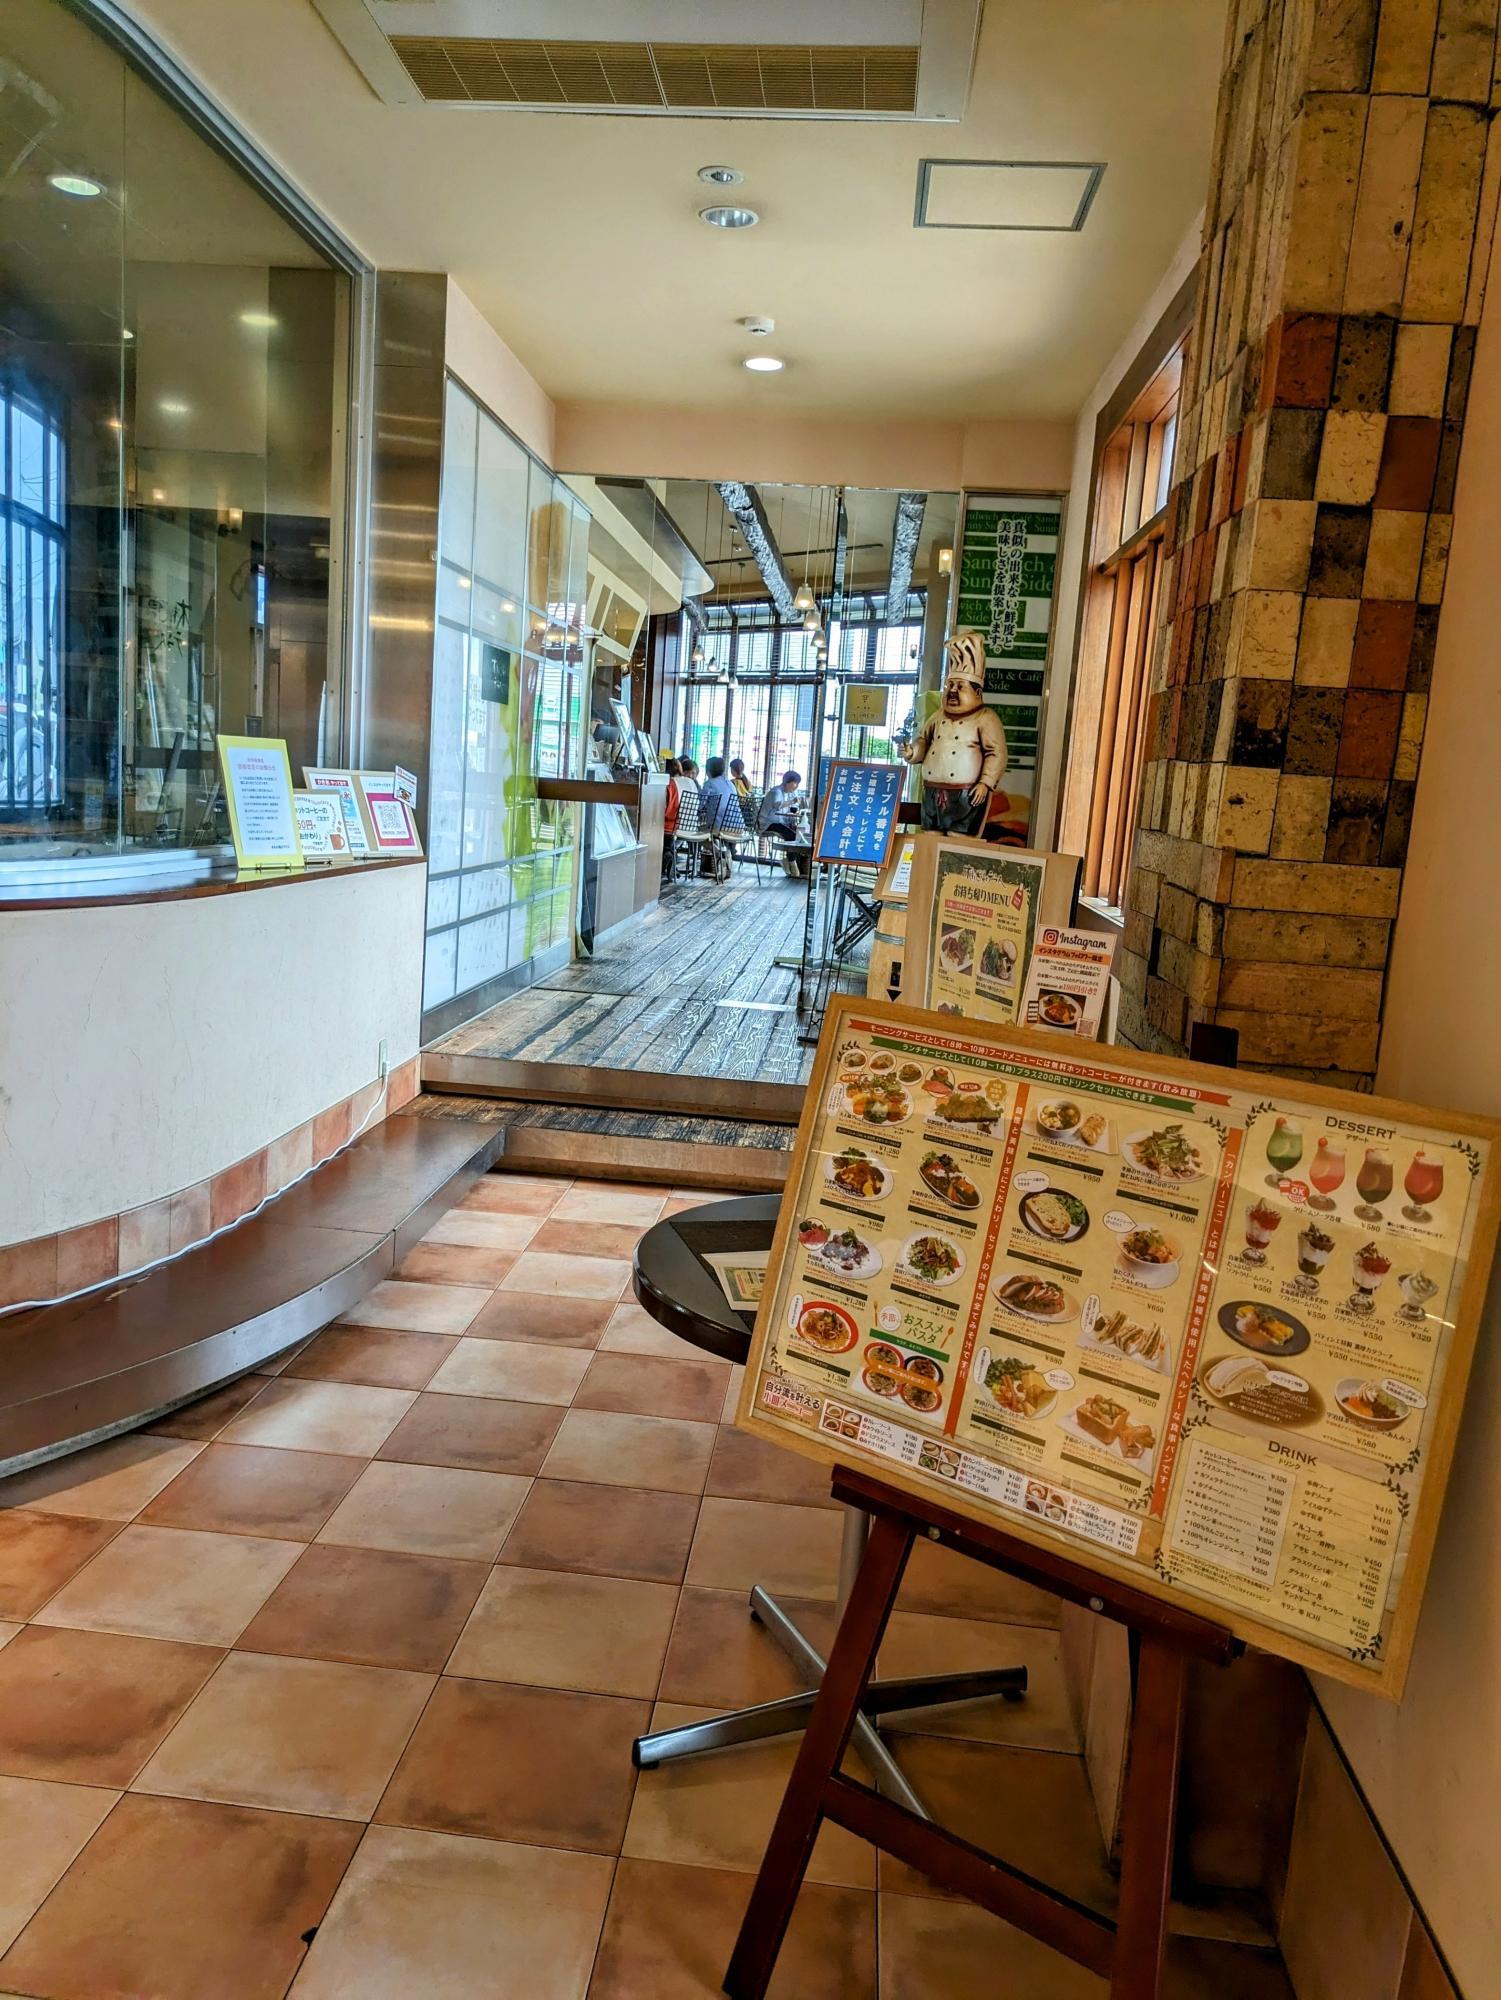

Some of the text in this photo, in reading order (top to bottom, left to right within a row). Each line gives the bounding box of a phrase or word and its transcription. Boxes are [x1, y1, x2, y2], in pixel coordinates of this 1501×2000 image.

[989, 520, 1012, 653] 美味しさを提案します。
[1003, 520, 1025, 648] 真似の出来ない鮮度と
[988, 681, 1010, 691] Side
[830, 768, 849, 828] お願い致します
[839, 770, 865, 858] ご注文・お会計を
[873, 773, 896, 851] テーブル番号を
[1059, 931, 1108, 951] Instagram
[1325, 1115, 1395, 1140] DESSERT
[1290, 1186, 1305, 1196] OK
[1168, 1211, 1196, 1224] ¥1,000
[1360, 1221, 1381, 1233] ¥580
[1252, 1283, 1271, 1293] ¥550
[1306, 1309, 1326, 1320] ¥550
[903, 1312, 945, 1336] おススメ
[905, 1325, 937, 1346] パスタ
[1362, 1330, 1383, 1342] ¥550
[1410, 1331, 1432, 1343] ¥320
[765, 1380, 821, 1410] 自分流を叶える
[1356, 1436, 1376, 1449] ¥580
[1267, 1439, 1318, 1467] DRINK
[1201, 1461, 1235, 1478] アイスコーヒー
[1278, 1457, 1301, 1470] ドリンク
[1291, 1520, 1324, 1538] アルコール
